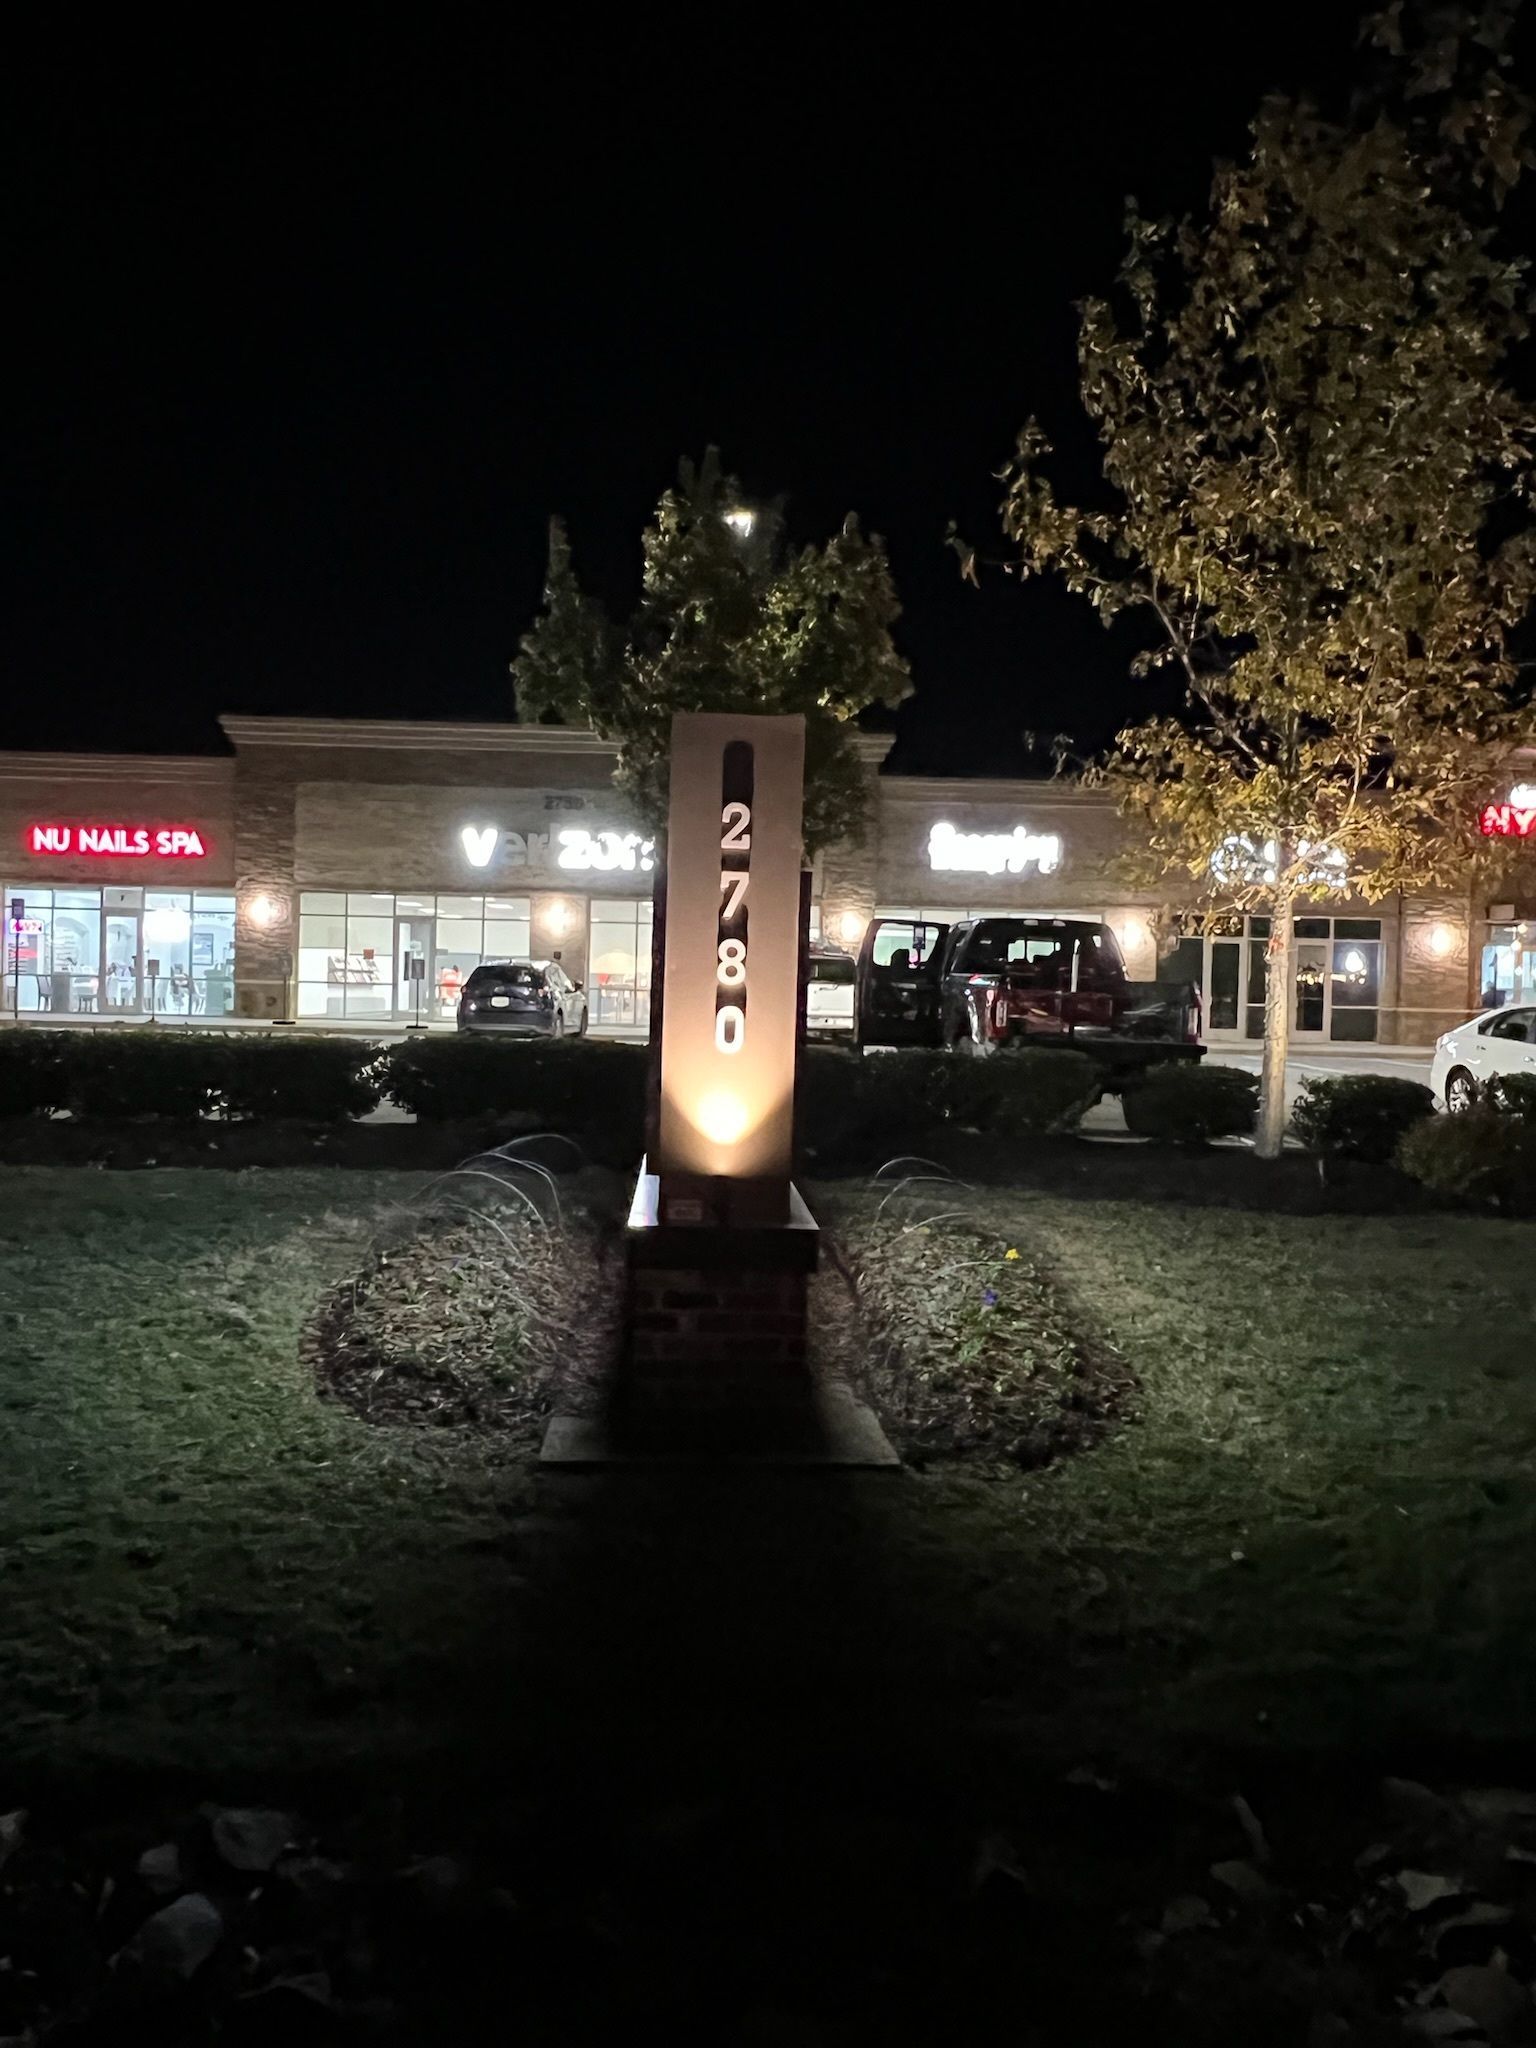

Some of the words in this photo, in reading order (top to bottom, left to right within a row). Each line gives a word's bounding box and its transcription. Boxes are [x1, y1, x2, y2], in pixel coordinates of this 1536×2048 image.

[33, 828, 70, 851] NU
[80, 829, 149, 854] NAILS
[157, 832, 204, 855] SPA
[716, 803, 752, 1054] 2780
